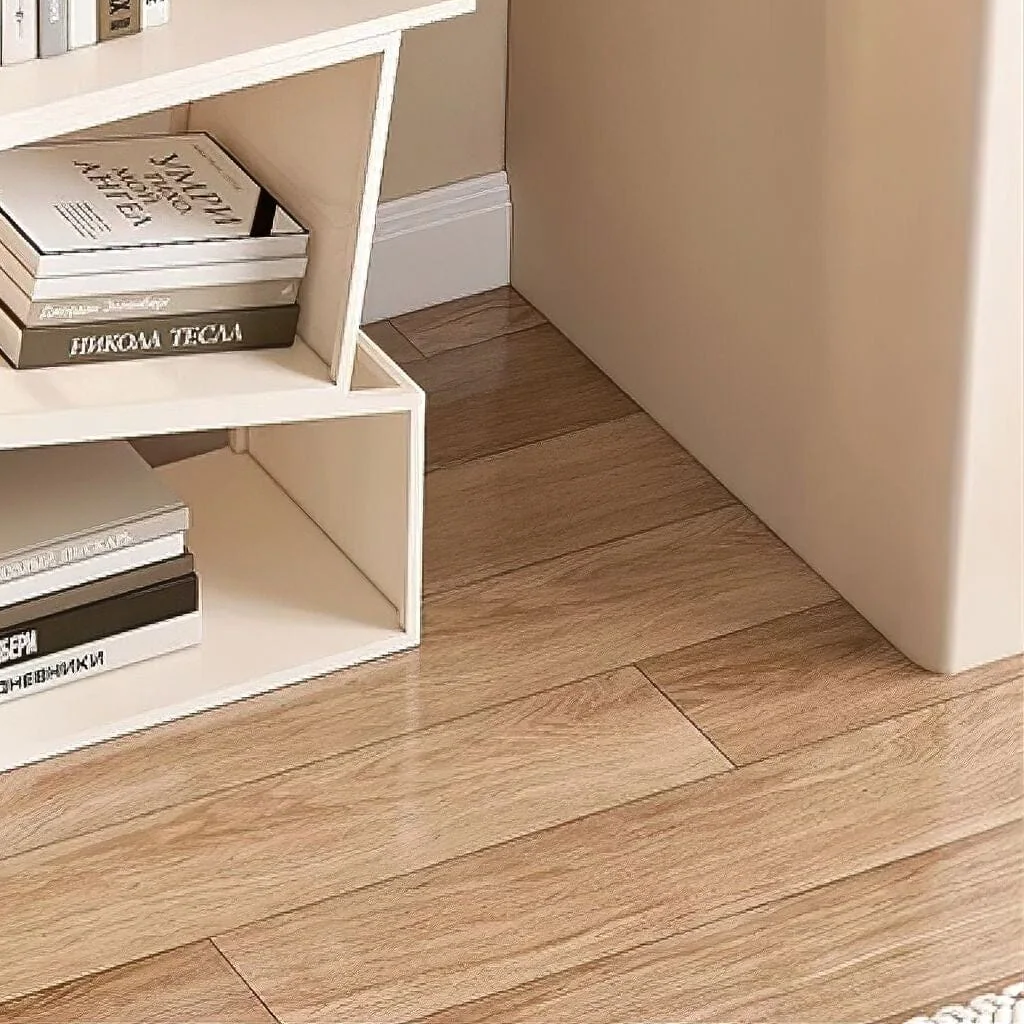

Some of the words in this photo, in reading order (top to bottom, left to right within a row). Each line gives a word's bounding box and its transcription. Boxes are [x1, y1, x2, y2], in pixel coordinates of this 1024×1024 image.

[72, 160, 153, 227] АНГЕЛ
[148, 152, 243, 225] УМРИ
[69, 329, 162, 357] НИКОЛА
[169, 322, 244, 347] ТЕСЛА
